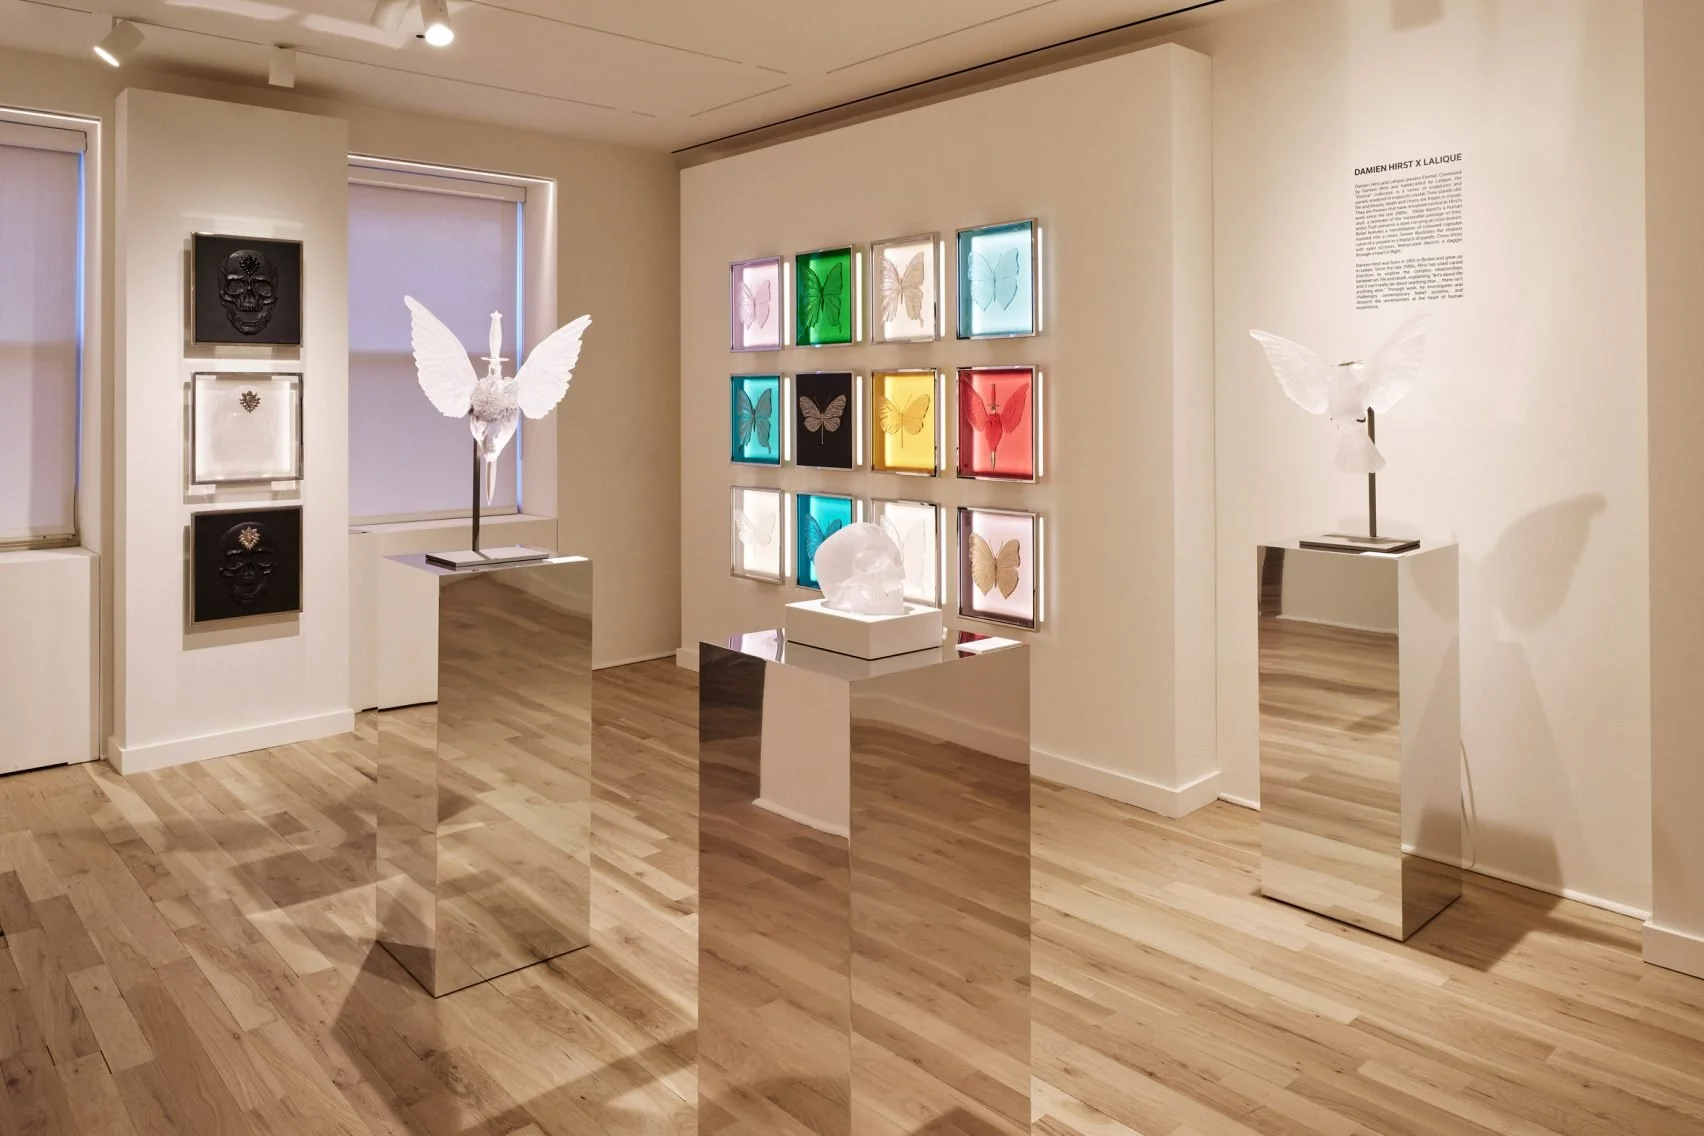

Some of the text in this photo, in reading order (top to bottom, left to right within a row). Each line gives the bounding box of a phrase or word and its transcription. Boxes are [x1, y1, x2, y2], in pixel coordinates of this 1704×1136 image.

[1355, 165, 1386, 176] DAMIEN
[1389, 161, 1413, 171] HIRST
[1424, 153, 1462, 165] LALIQUE
